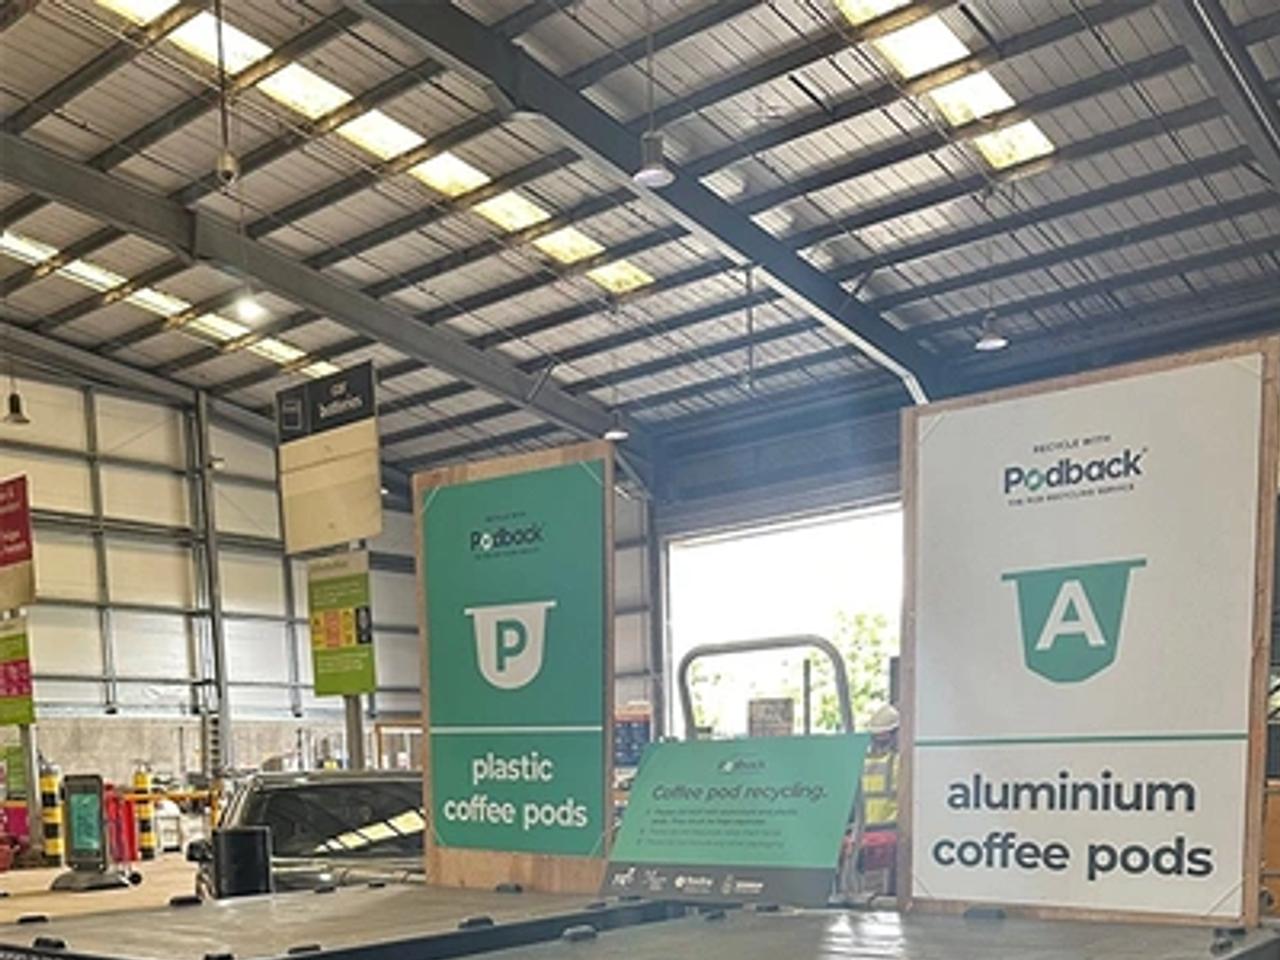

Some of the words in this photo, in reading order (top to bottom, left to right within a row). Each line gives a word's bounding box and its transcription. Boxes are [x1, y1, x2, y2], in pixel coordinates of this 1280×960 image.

[1004, 449, 1142, 494] Podback
[1034, 578, 1107, 651] A
[495, 618, 528, 672] P
[472, 751, 554, 785] plastic
[443, 795, 516, 825] coffee
[523, 798, 588, 830] pods
[946, 770, 1196, 812] aluminium
[932, 832, 1070, 870] coffee
[1086, 836, 1214, 881] pods
